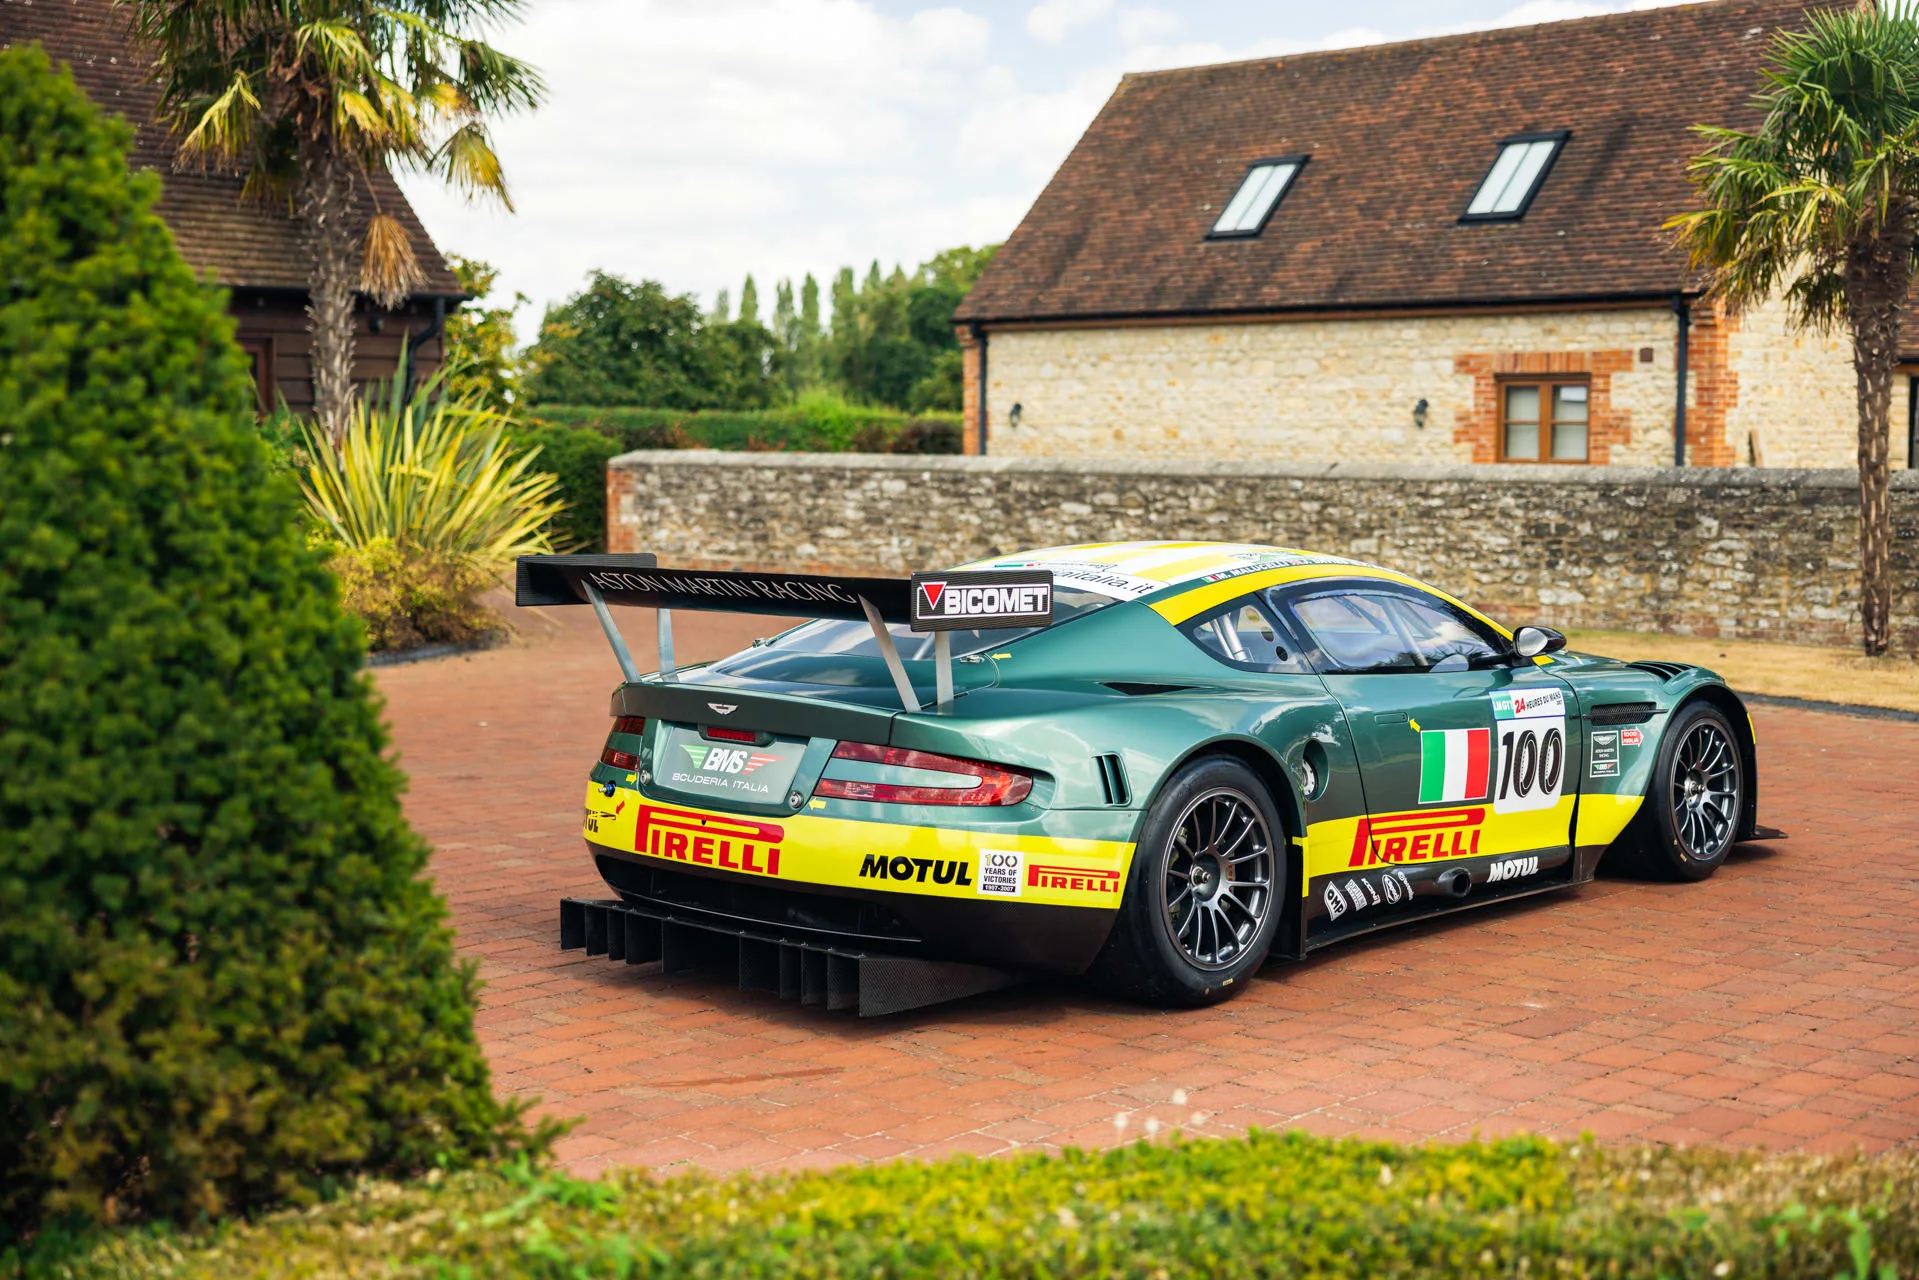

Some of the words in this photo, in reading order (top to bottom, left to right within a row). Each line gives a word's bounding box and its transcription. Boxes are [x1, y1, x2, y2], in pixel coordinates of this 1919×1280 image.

[589, 572, 669, 592] ASTON
[661, 575, 761, 598] MARTIN
[752, 579, 857, 604] RACING
[944, 587, 1048, 614] BICOMET
[1514, 698, 1526, 714] 24
[703, 747, 748, 775] BMS
[1499, 727, 1562, 801] 100
[672, 772, 728, 788] SCUDERIA
[732, 780, 769, 794] ITALIA
[634, 804, 785, 876] PIRELLI
[1348, 807, 1485, 867] PIRELLI
[859, 853, 972, 886] MOTUL
[983, 875, 1017, 885] VICTORIES
[985, 867, 1006, 876] YEARS
[1008, 869, 1017, 877] OF
[1028, 864, 1120, 893] PIRELLI
[1486, 856, 1539, 883] MOTUL
[1327, 889, 1344, 914] OMP
